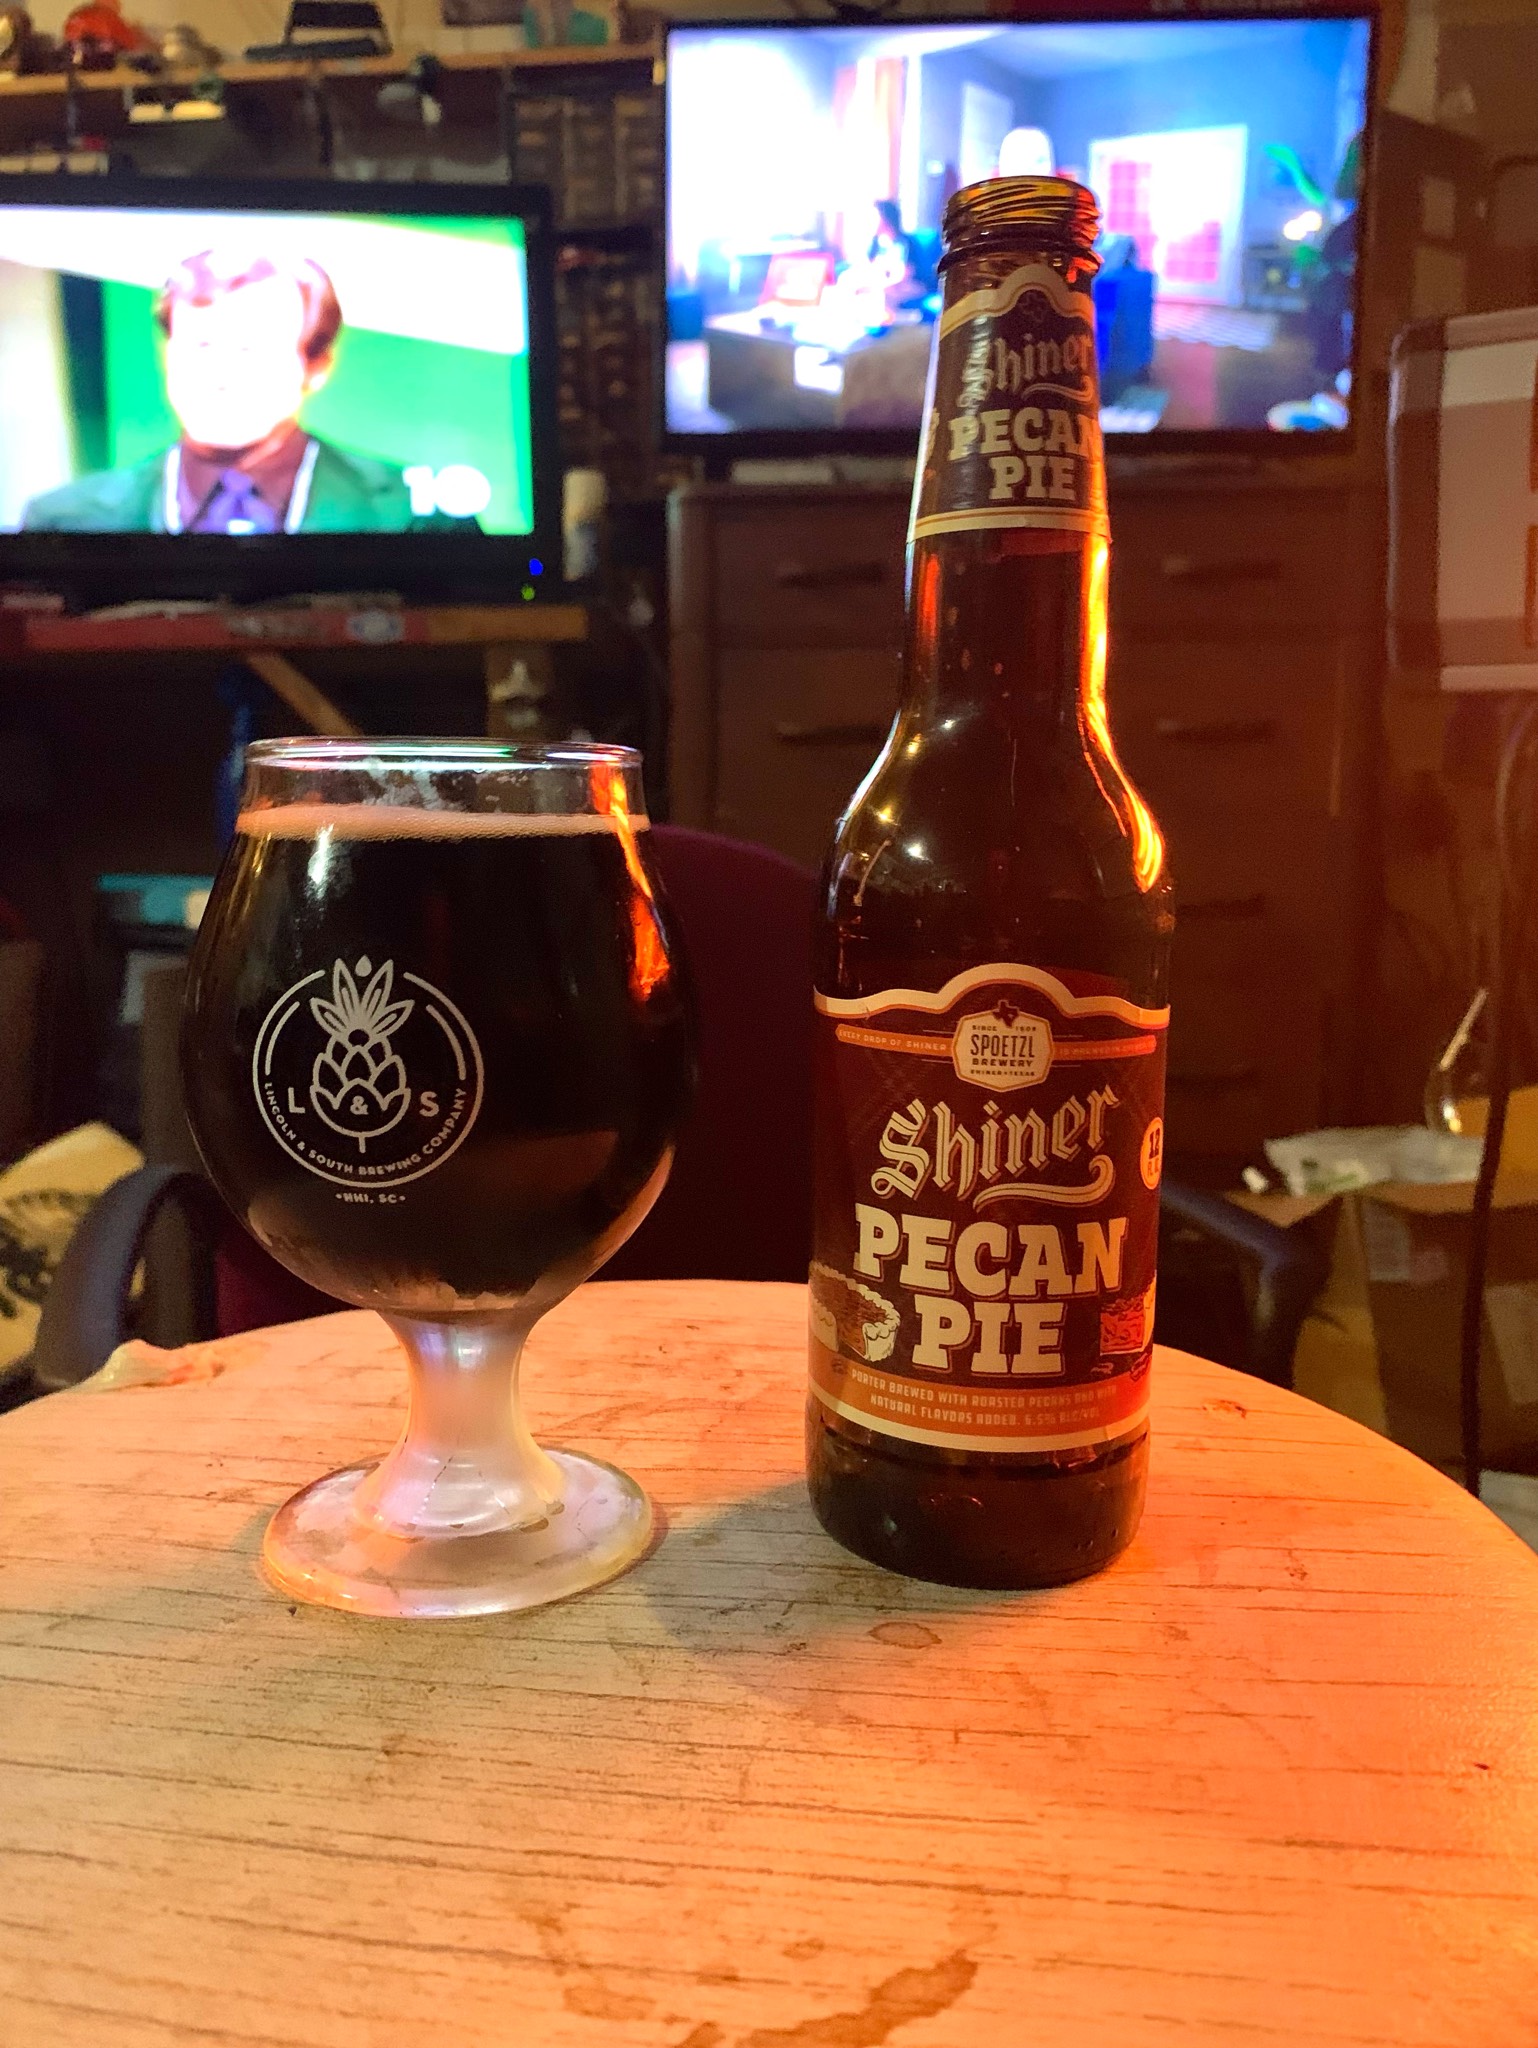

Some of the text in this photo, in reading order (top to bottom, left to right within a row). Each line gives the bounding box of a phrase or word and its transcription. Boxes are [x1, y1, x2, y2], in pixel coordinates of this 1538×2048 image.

[989, 455, 1076, 501] PIE
[863, 1034, 887, 1044] DROP
[906, 1041, 947, 1051] SHINER
[970, 1034, 1035, 1058] SPOETZL
[972, 1058, 1034, 1067] BREWERY
[288, 1087, 440, 1117] L & S
[264, 1082, 467, 1176] LINCOLN & SOUTH BREWING COMPANY
[871, 1084, 1121, 1212] Shiner
[853, 1202, 1129, 1297] PECAN
[911, 1294, 1066, 1376] PIE
[852, 1368, 886, 1391] PORTER
[889, 1381, 934, 1401] BREWED
[938, 1391, 967, 1406] WITH
[972, 1395, 1025, 1408] ROASTED
[870, 1393, 917, 1416] NATURAL
[921, 1406, 972, 1424] FLAVORS
